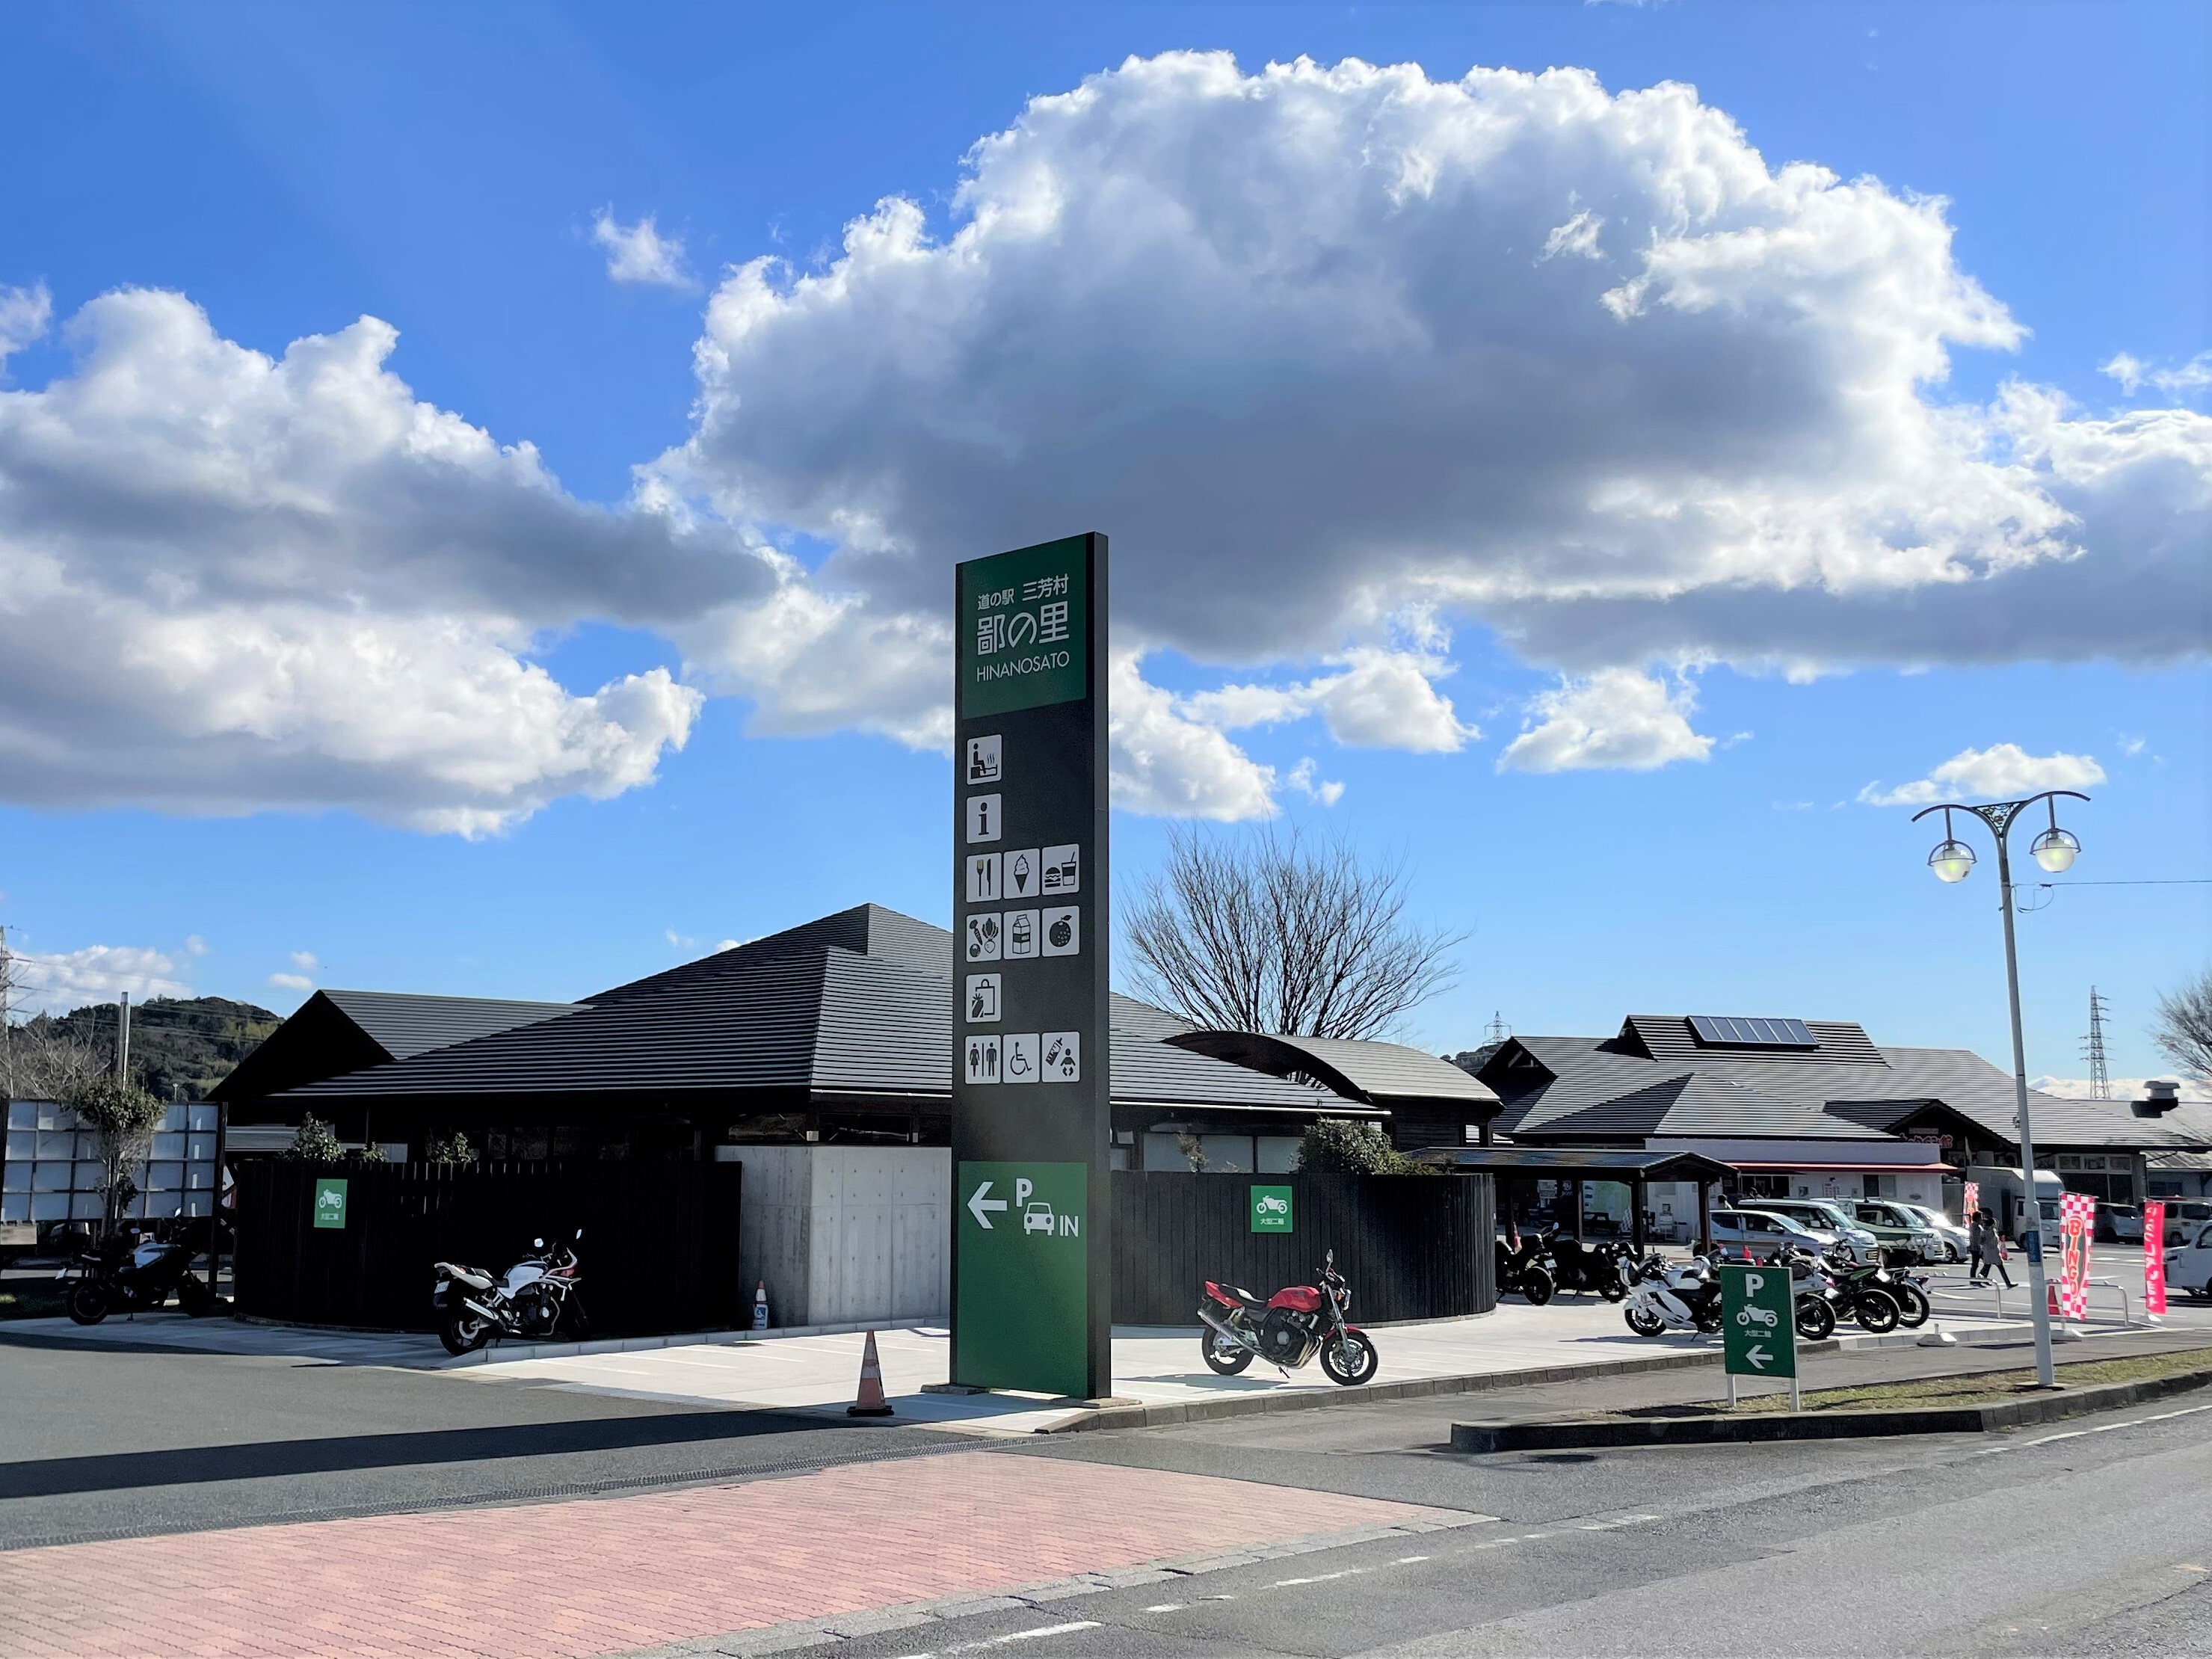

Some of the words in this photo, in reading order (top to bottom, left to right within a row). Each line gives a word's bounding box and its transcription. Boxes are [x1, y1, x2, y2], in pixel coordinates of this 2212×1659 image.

[977, 588, 1014, 611] 道の駅
[1022, 573, 1069, 601] 三芳村
[976, 600, 1070, 656] 鄙の里
[976, 650, 1070, 682] HINANOSATO
[1015, 1178, 1033, 1207] P
[1059, 1214, 1079, 1237] IN
[2068, 1219, 2083, 1296] BINGO
[1745, 1273, 1764, 1298] P
